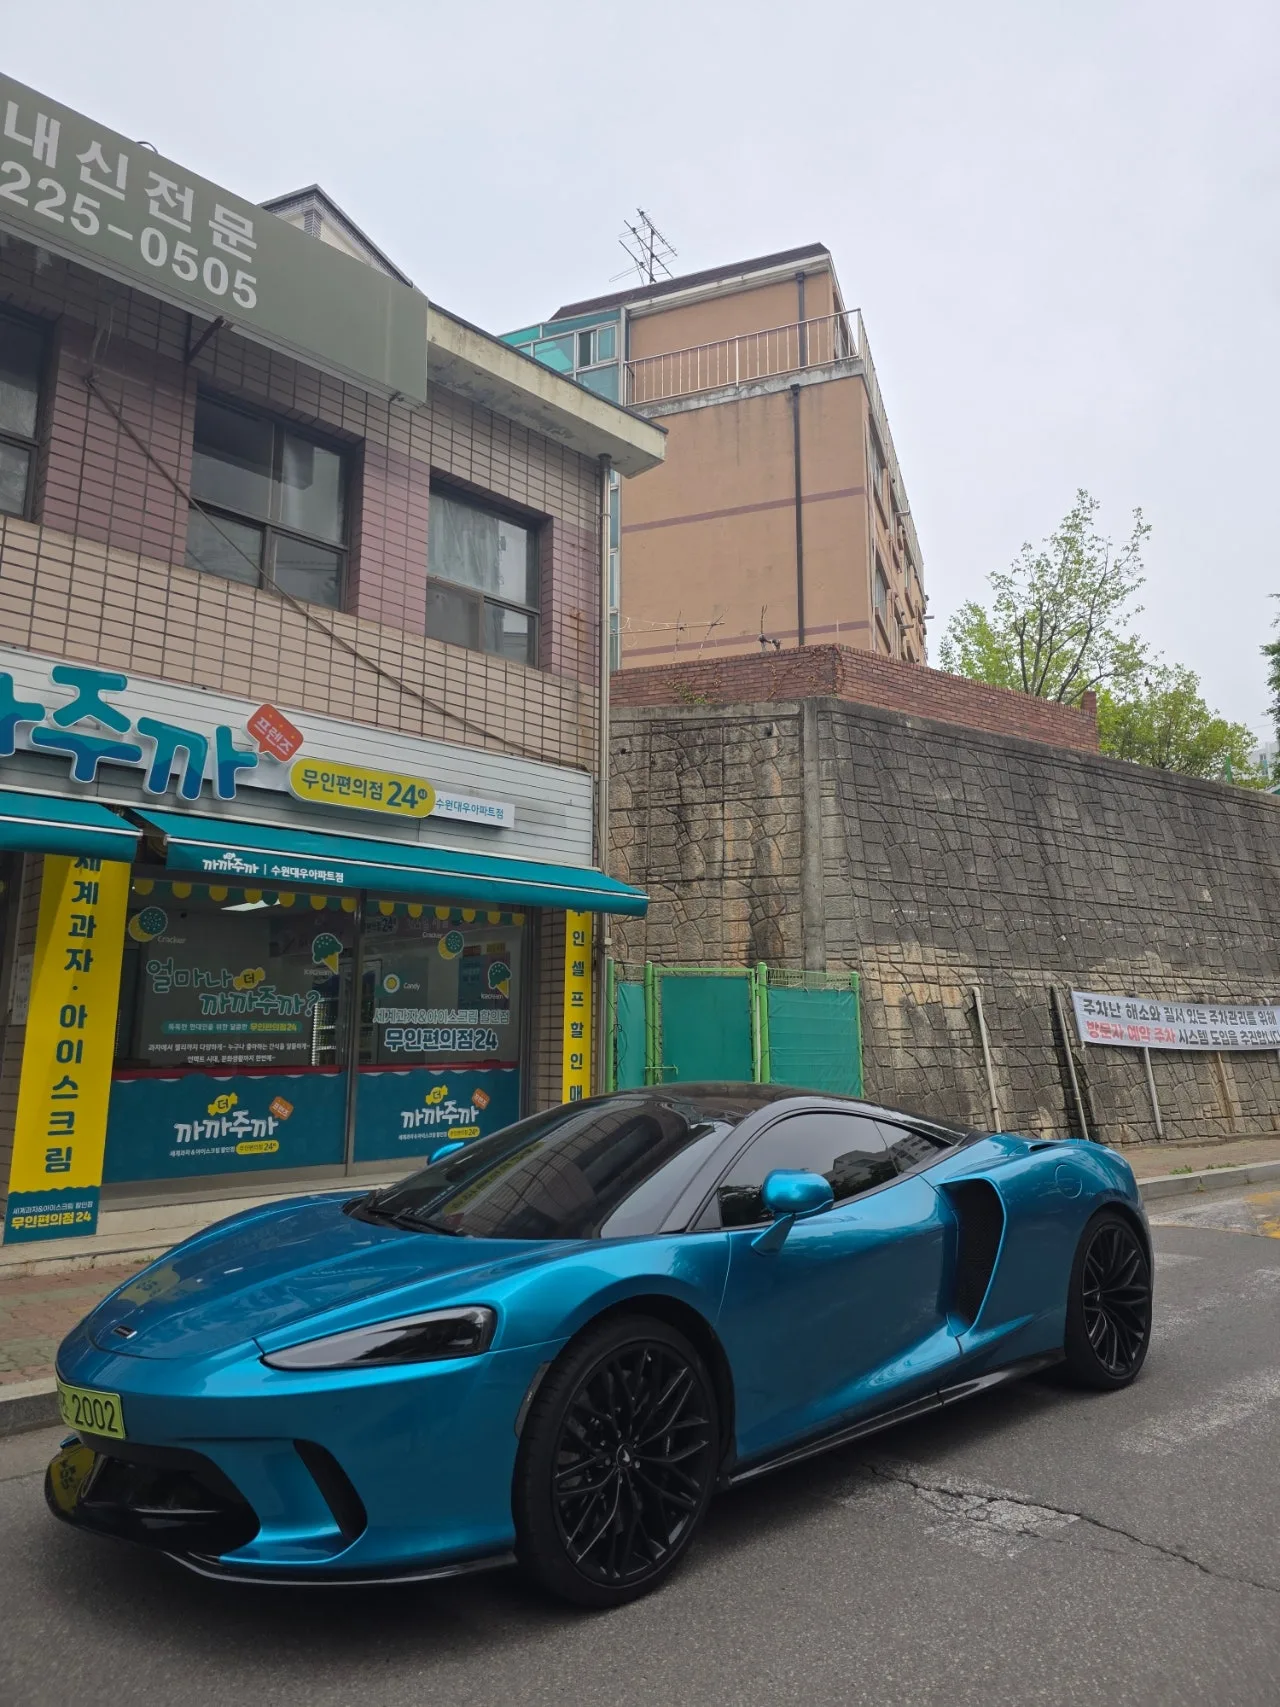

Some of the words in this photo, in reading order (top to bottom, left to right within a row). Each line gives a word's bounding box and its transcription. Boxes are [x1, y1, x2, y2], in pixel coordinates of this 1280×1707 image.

[4, 100, 257, 264] 내신전문
[0, 160, 257, 309] 225-0505
[253, 716, 294, 756] 프렌즈
[302, 768, 384, 801] 무인편의점
[435, 798, 504, 820] 수원대우아파트점
[202, 858, 259, 875] 까까주까
[271, 864, 344, 884] 수원대우아파트점
[145, 956, 234, 994] 얼마나
[243, 972, 255, 985] 더
[403, 982, 420, 991] Candy
[199, 984, 321, 1017] 까까주까?
[1083, 998, 1122, 1019] 주차난
[1125, 1002, 1161, 1022] 해소와
[1163, 1006, 1186, 1024] 질서
[1186, 1008, 1208, 1025] 있는
[1208, 1009, 1258, 1026] 주차관리를
[1257, 1010, 1278, 1026] 위해
[372, 1007, 479, 1025] 세계과자&아이스크림
[479, 1009, 510, 1025] 할인점
[384, 1027, 499, 1052] 무인편의점24
[1086, 1020, 1125, 1041] 방문자
[1127, 1023, 1151, 1042] 예약
[1153, 1026, 1176, 1044] 주차
[1178, 1028, 1209, 1046] 시스템
[1210, 1029, 1239, 1046] 도입을
[217, 1098, 229, 1110] 더
[401, 1100, 479, 1129] 까까주까
[173, 1109, 279, 1143] 까까주까
[11, 1211, 75, 1230] 무인편의점
[75, 1210, 92, 1224] 24
[72, 1393, 119, 1433] 2002
